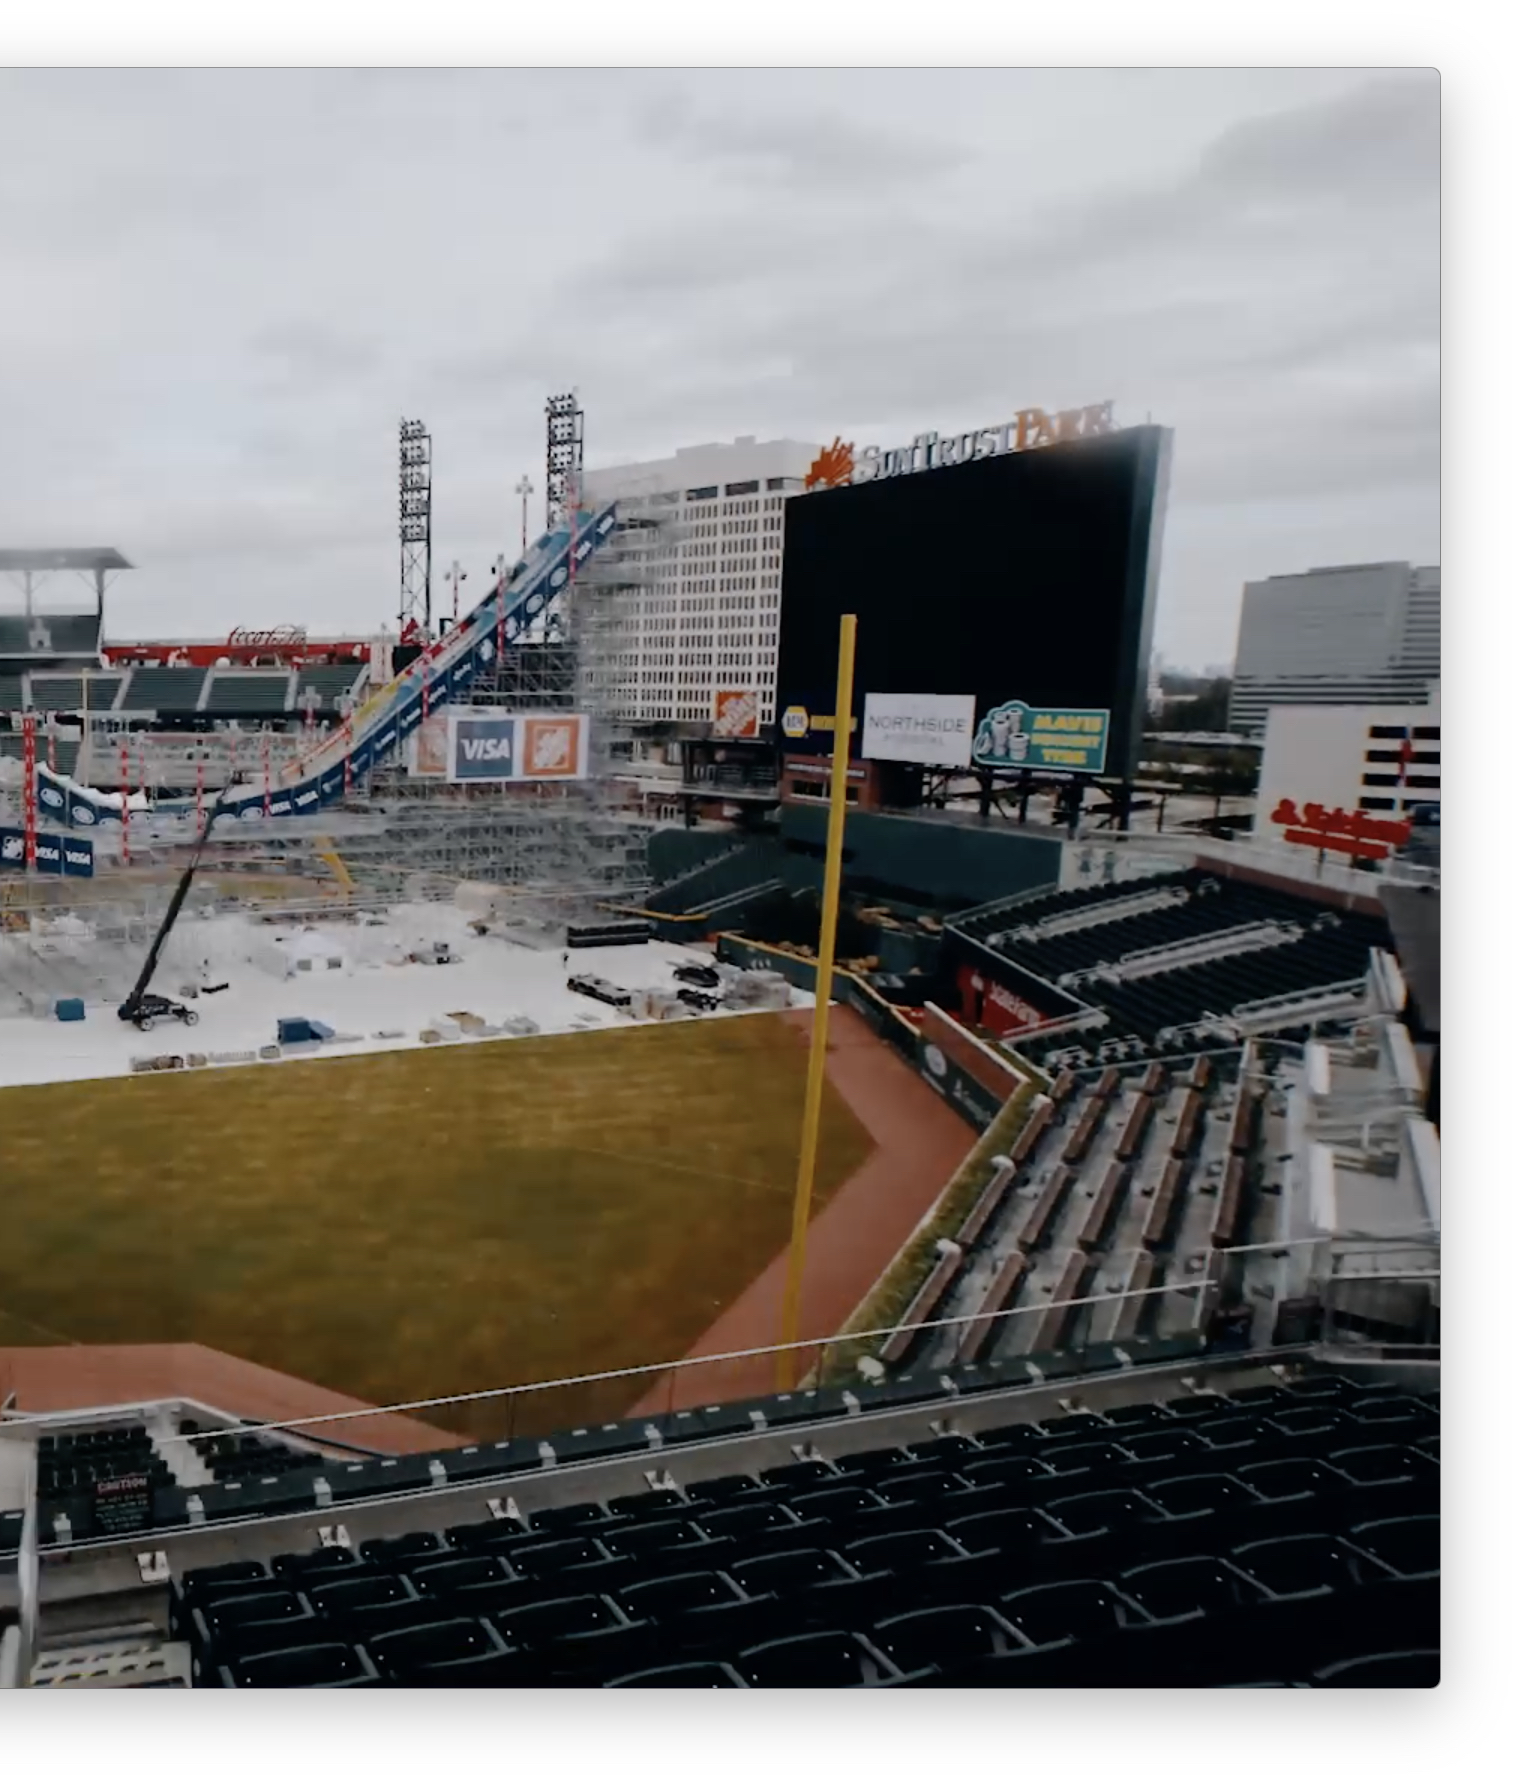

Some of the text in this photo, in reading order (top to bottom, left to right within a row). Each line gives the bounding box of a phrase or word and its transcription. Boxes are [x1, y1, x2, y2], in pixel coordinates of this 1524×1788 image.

[868, 715, 967, 733] NORTHSIDE
[460, 738, 511, 760] VISA
[65, 849, 91, 866] VISA
